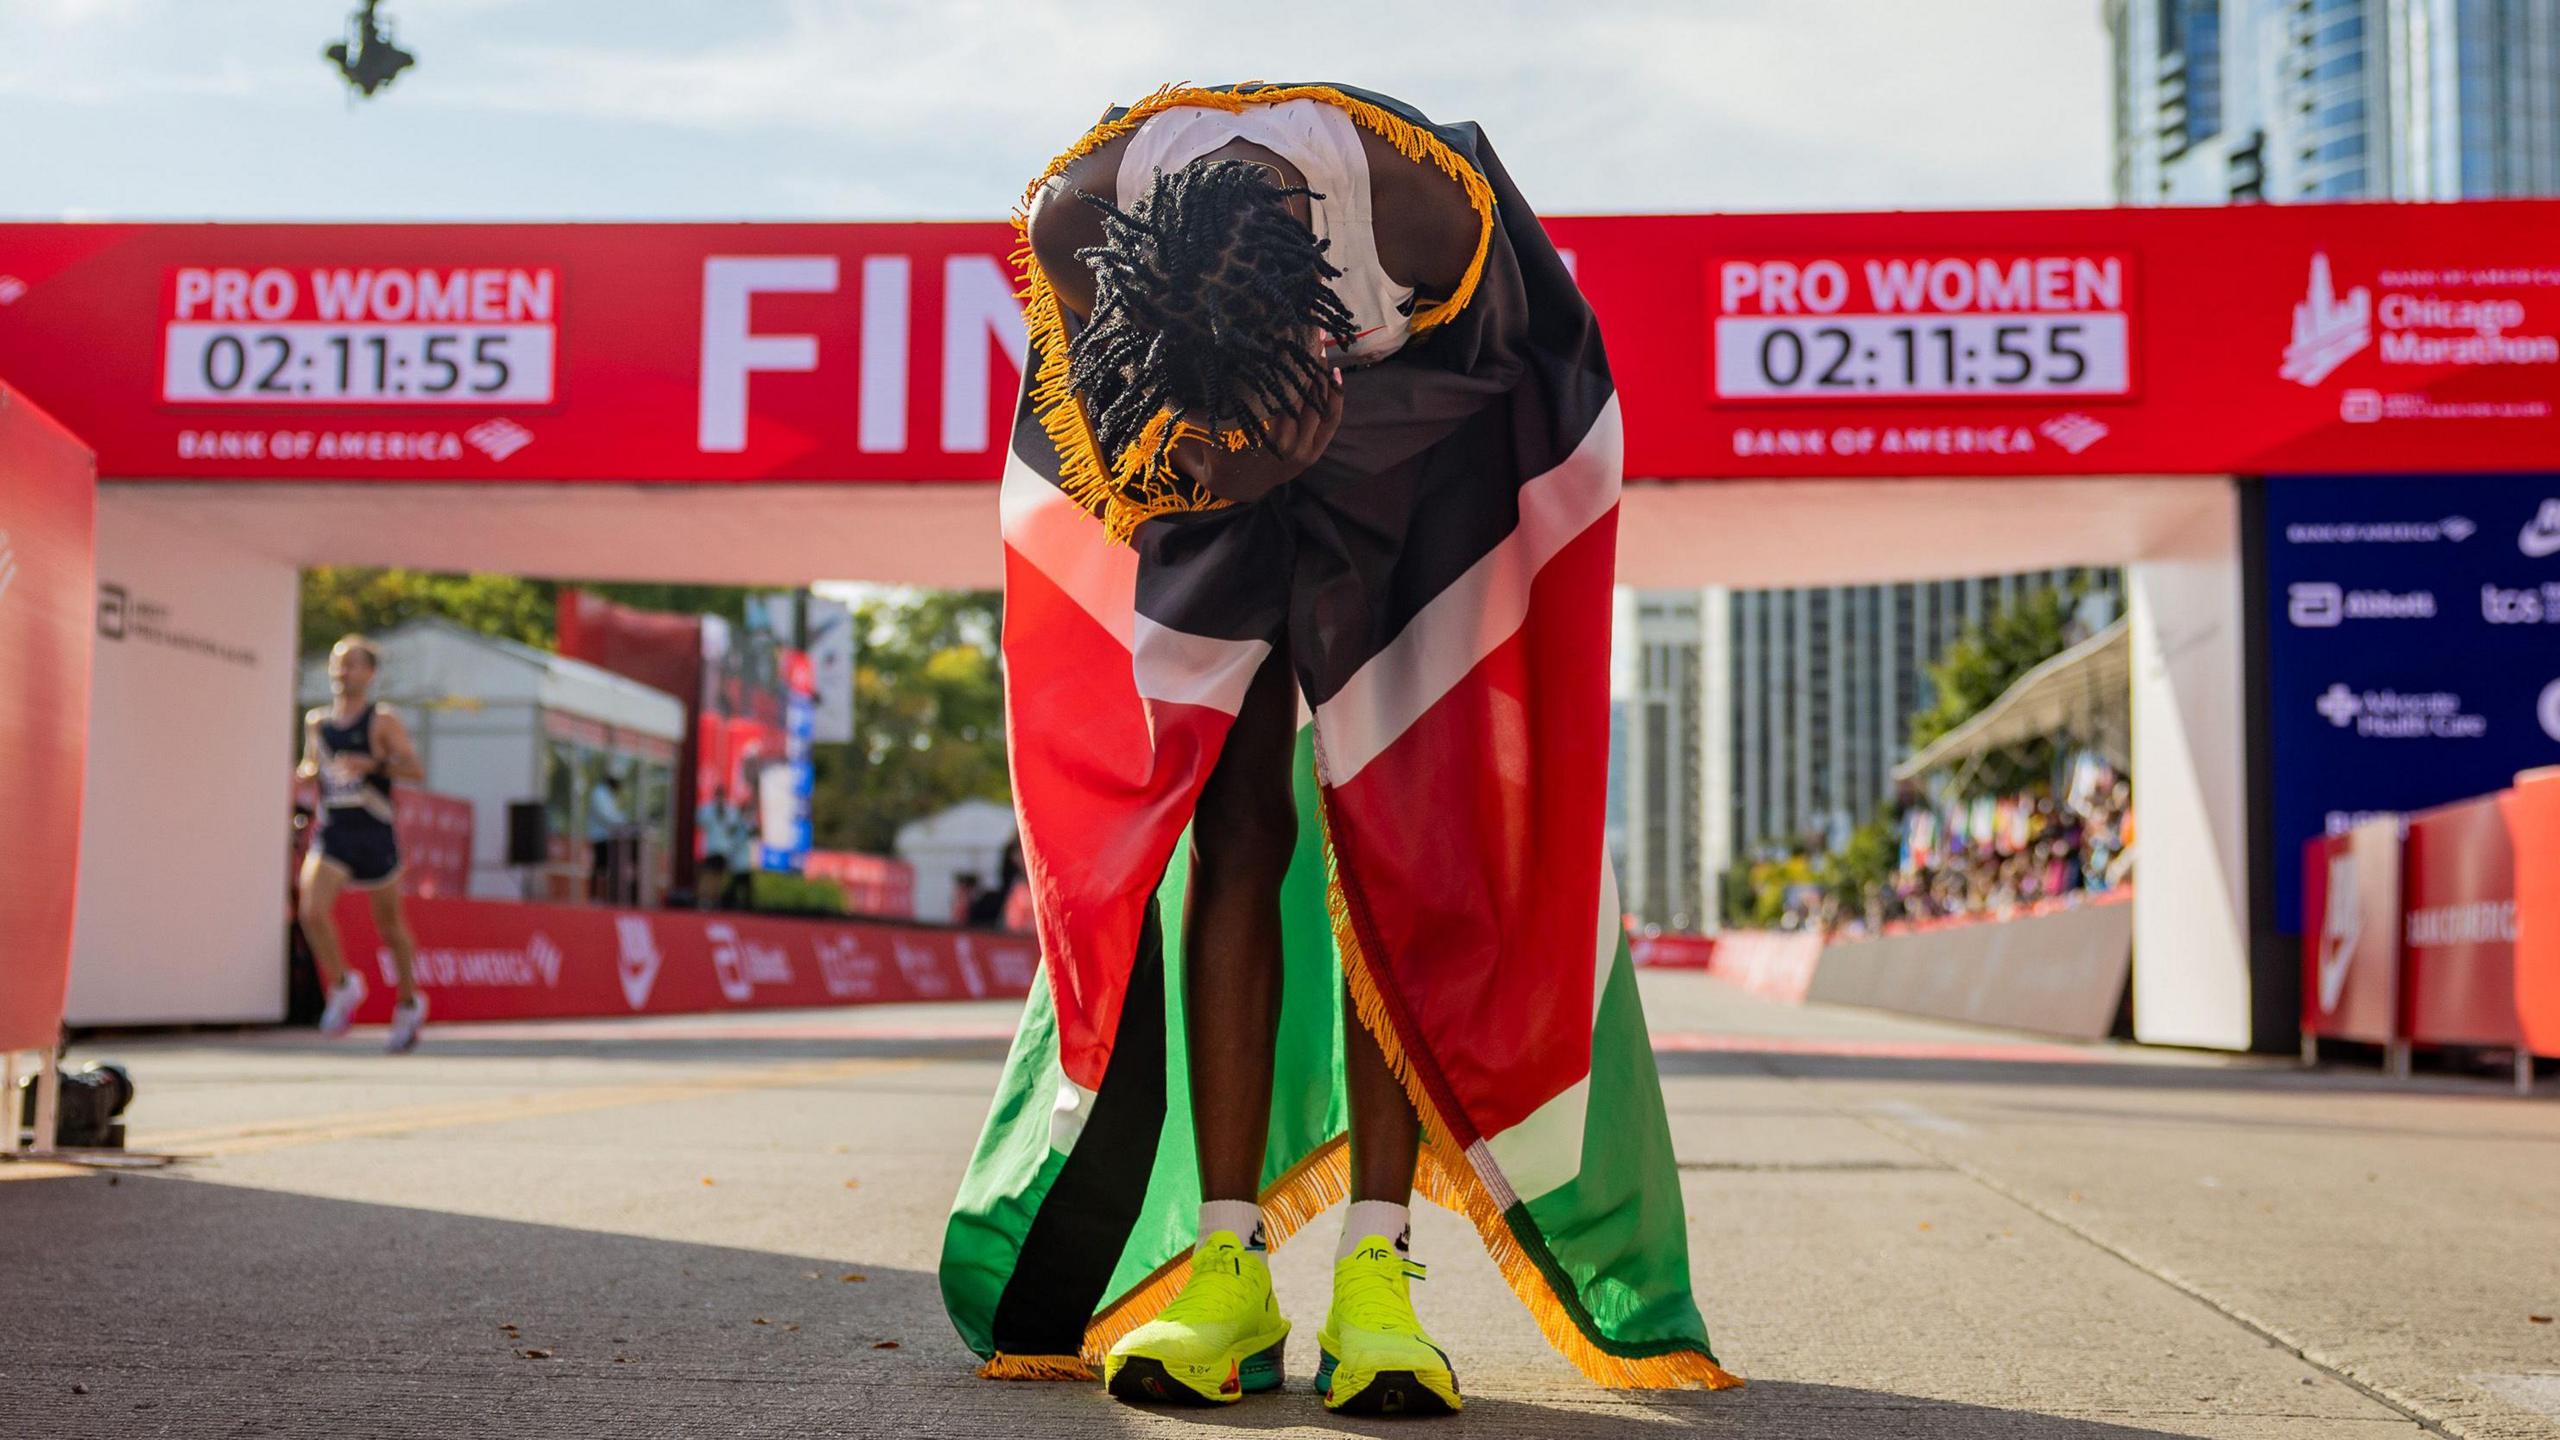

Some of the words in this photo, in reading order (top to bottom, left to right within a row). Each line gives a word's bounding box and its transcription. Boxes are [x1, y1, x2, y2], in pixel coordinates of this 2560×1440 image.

[176, 269, 296, 320] PRO
[311, 269, 553, 320] WOMEN
[1721, 261, 1848, 313] PRO
[1864, 257, 2121, 311] WOMEN
[2378, 293, 2525, 336] Chicago
[205, 334, 509, 393] 02:11:55
[699, 254, 1029, 452] FIN
[1760, 325, 2086, 386] 02:11:55
[2380, 331, 2559, 364] Marathon
[178, 430, 267, 459] BANK
[269, 430, 314, 459] OF
[316, 431, 462, 460] AMERICA
[1733, 428, 1826, 456] BANK
[1831, 427, 1876, 455] OF
[1881, 427, 2034, 454] AMERICA
